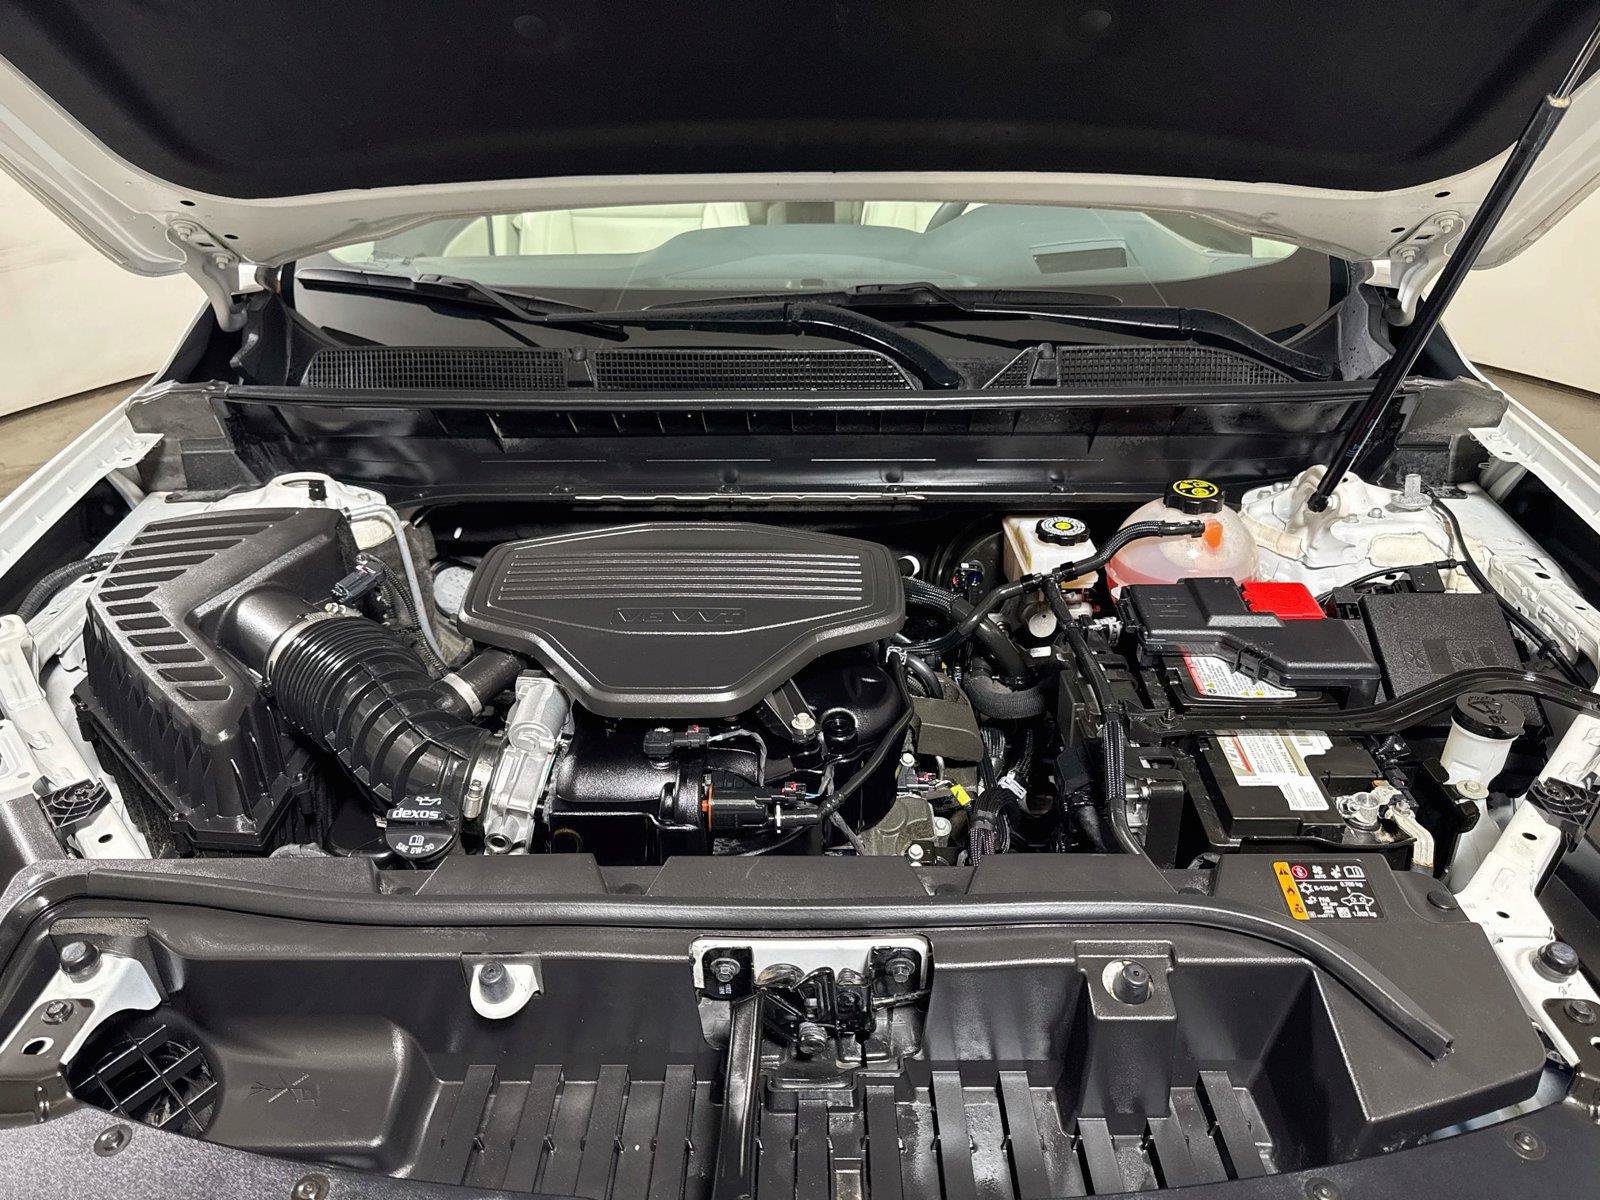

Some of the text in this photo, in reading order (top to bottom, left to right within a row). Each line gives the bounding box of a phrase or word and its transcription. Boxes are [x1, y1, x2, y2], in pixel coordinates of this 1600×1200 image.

[392, 807, 441, 819] dexos
[395, 842, 435, 855] SAE 5W-30
